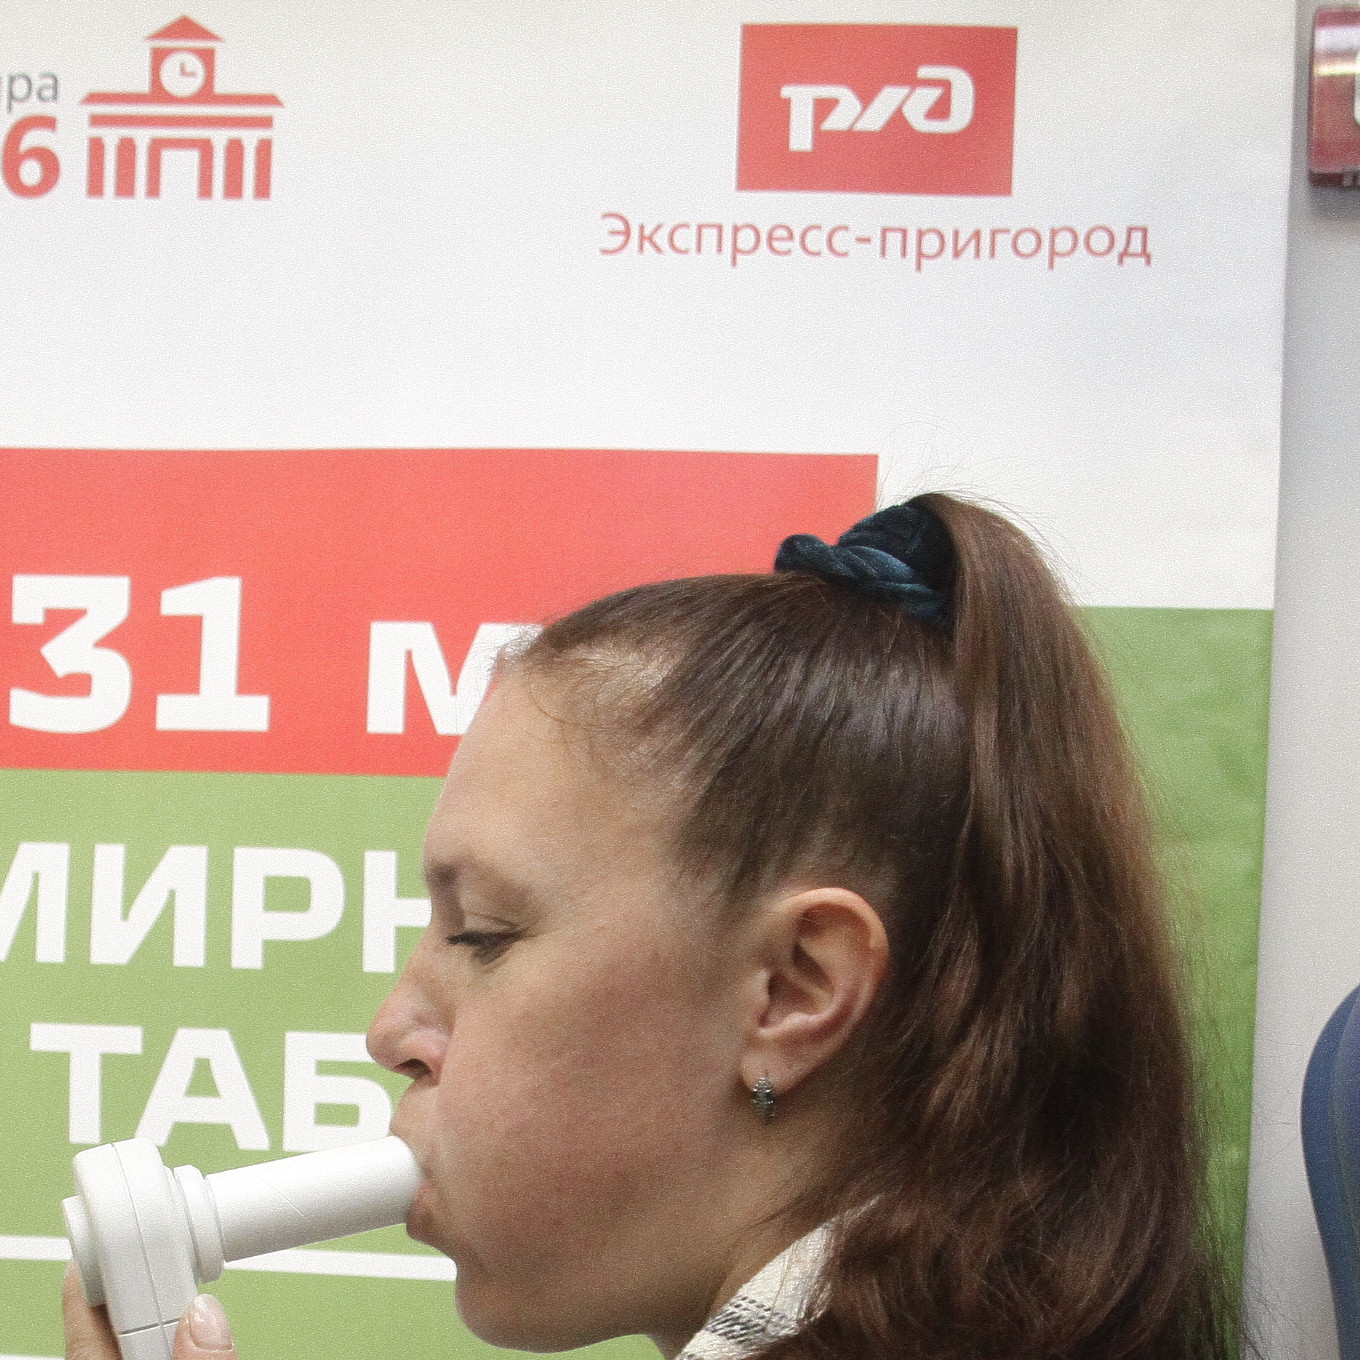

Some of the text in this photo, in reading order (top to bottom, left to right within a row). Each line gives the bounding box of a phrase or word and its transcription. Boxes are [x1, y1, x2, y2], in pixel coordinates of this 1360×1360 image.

[599, 212, 1153, 272] Экспресс-пригород
[8, 574, 271, 734] 31
[29, 1021, 393, 1153] ТАБ
